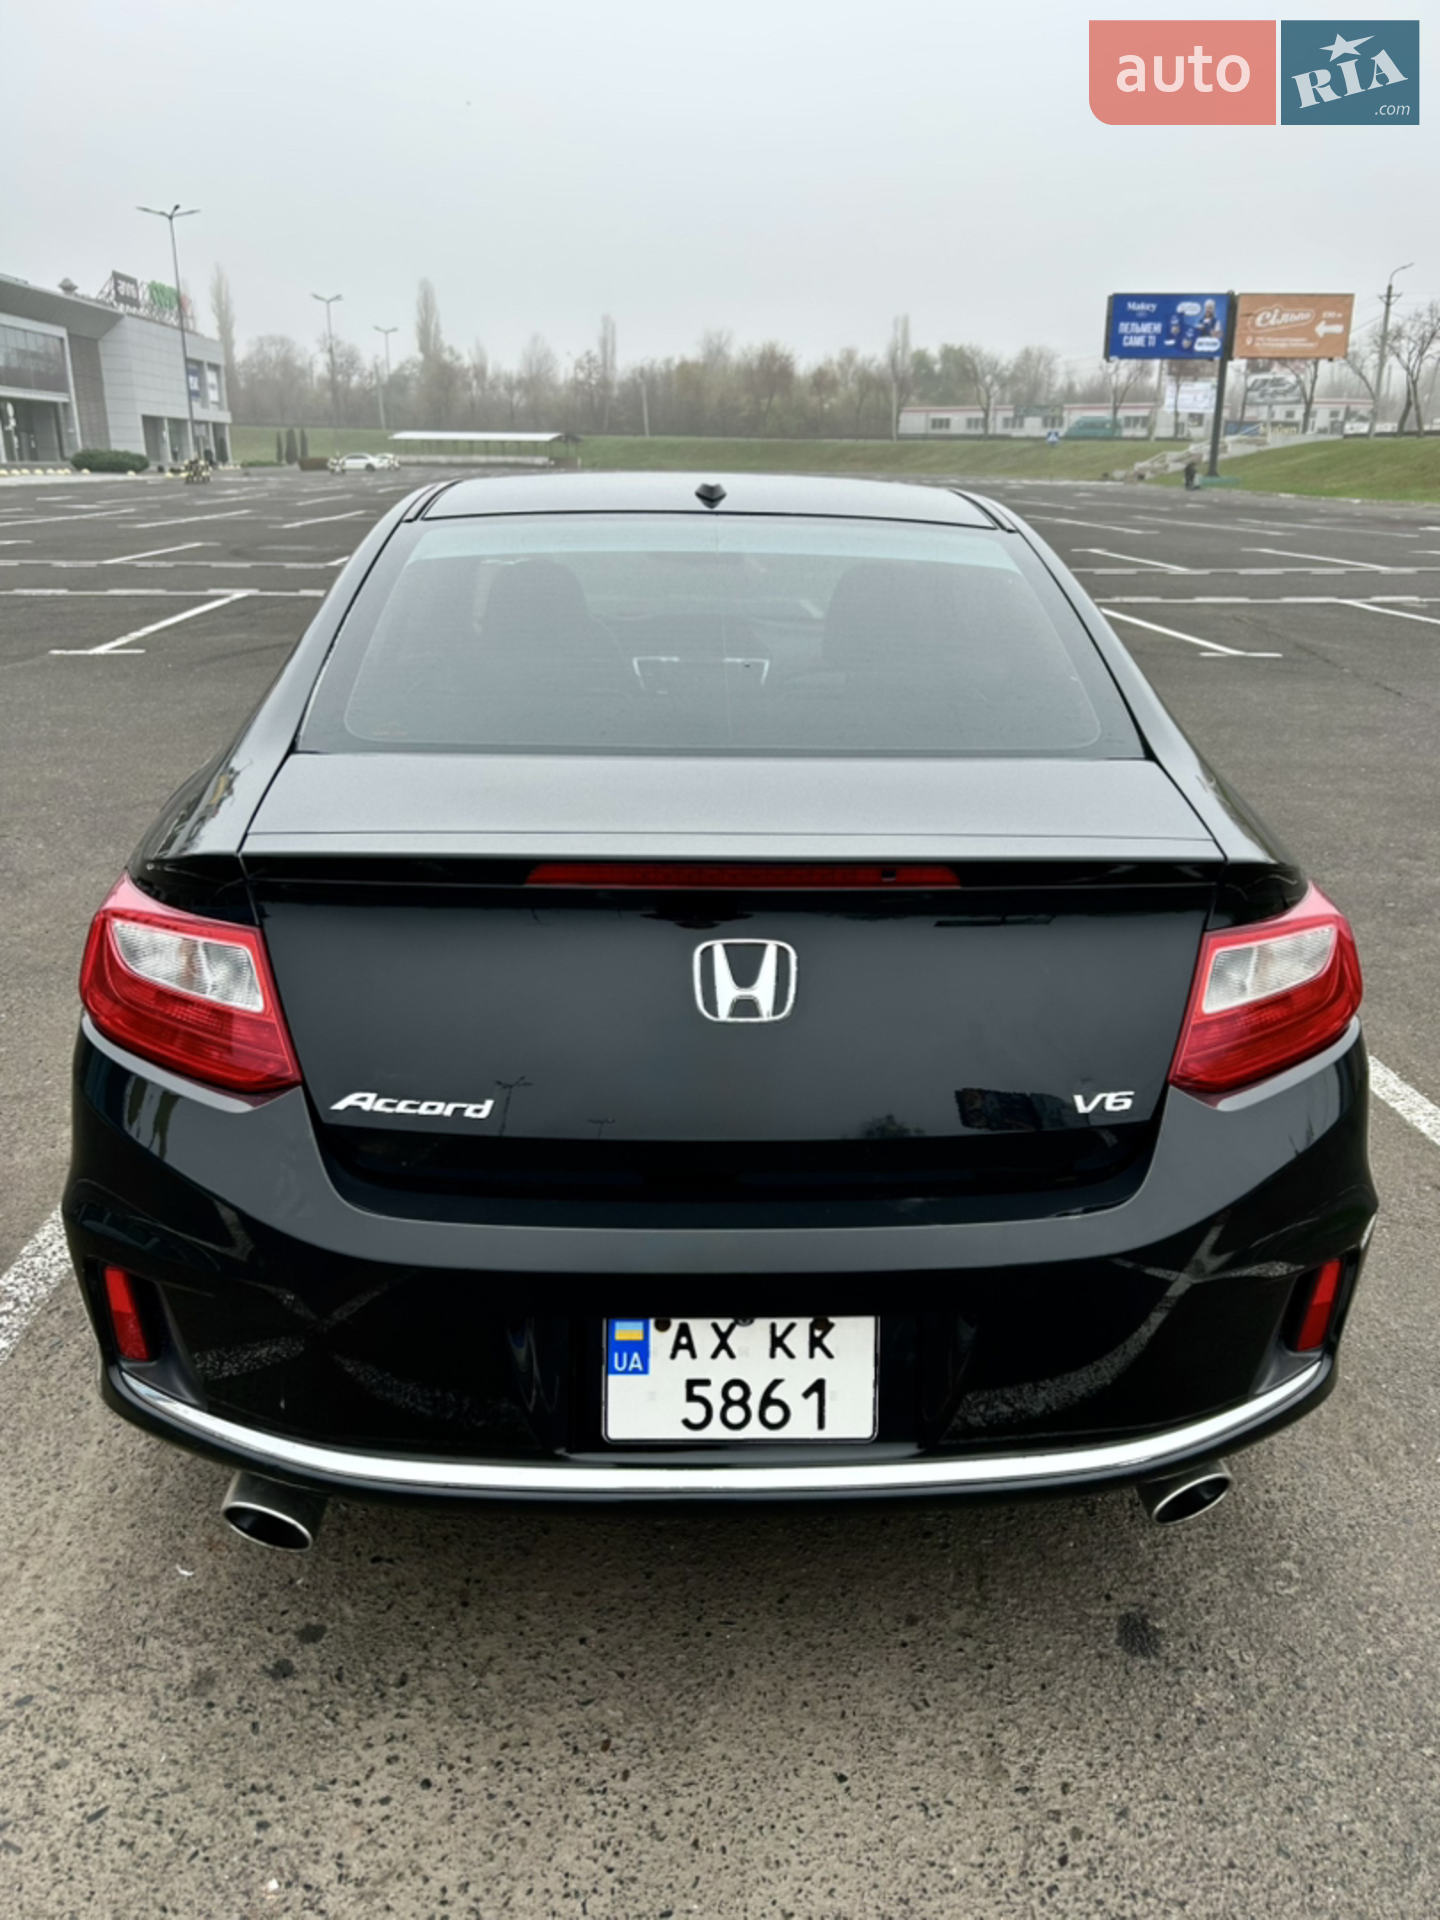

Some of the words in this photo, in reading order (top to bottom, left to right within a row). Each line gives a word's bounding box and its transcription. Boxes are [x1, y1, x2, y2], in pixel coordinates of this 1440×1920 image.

[330, 1092, 495, 1119] Accord
[1073, 1091, 1135, 1114] V6
[669, 1322, 738, 1360] AX
[614, 1352, 643, 1371] UA
[681, 1378, 826, 1431] 5861
